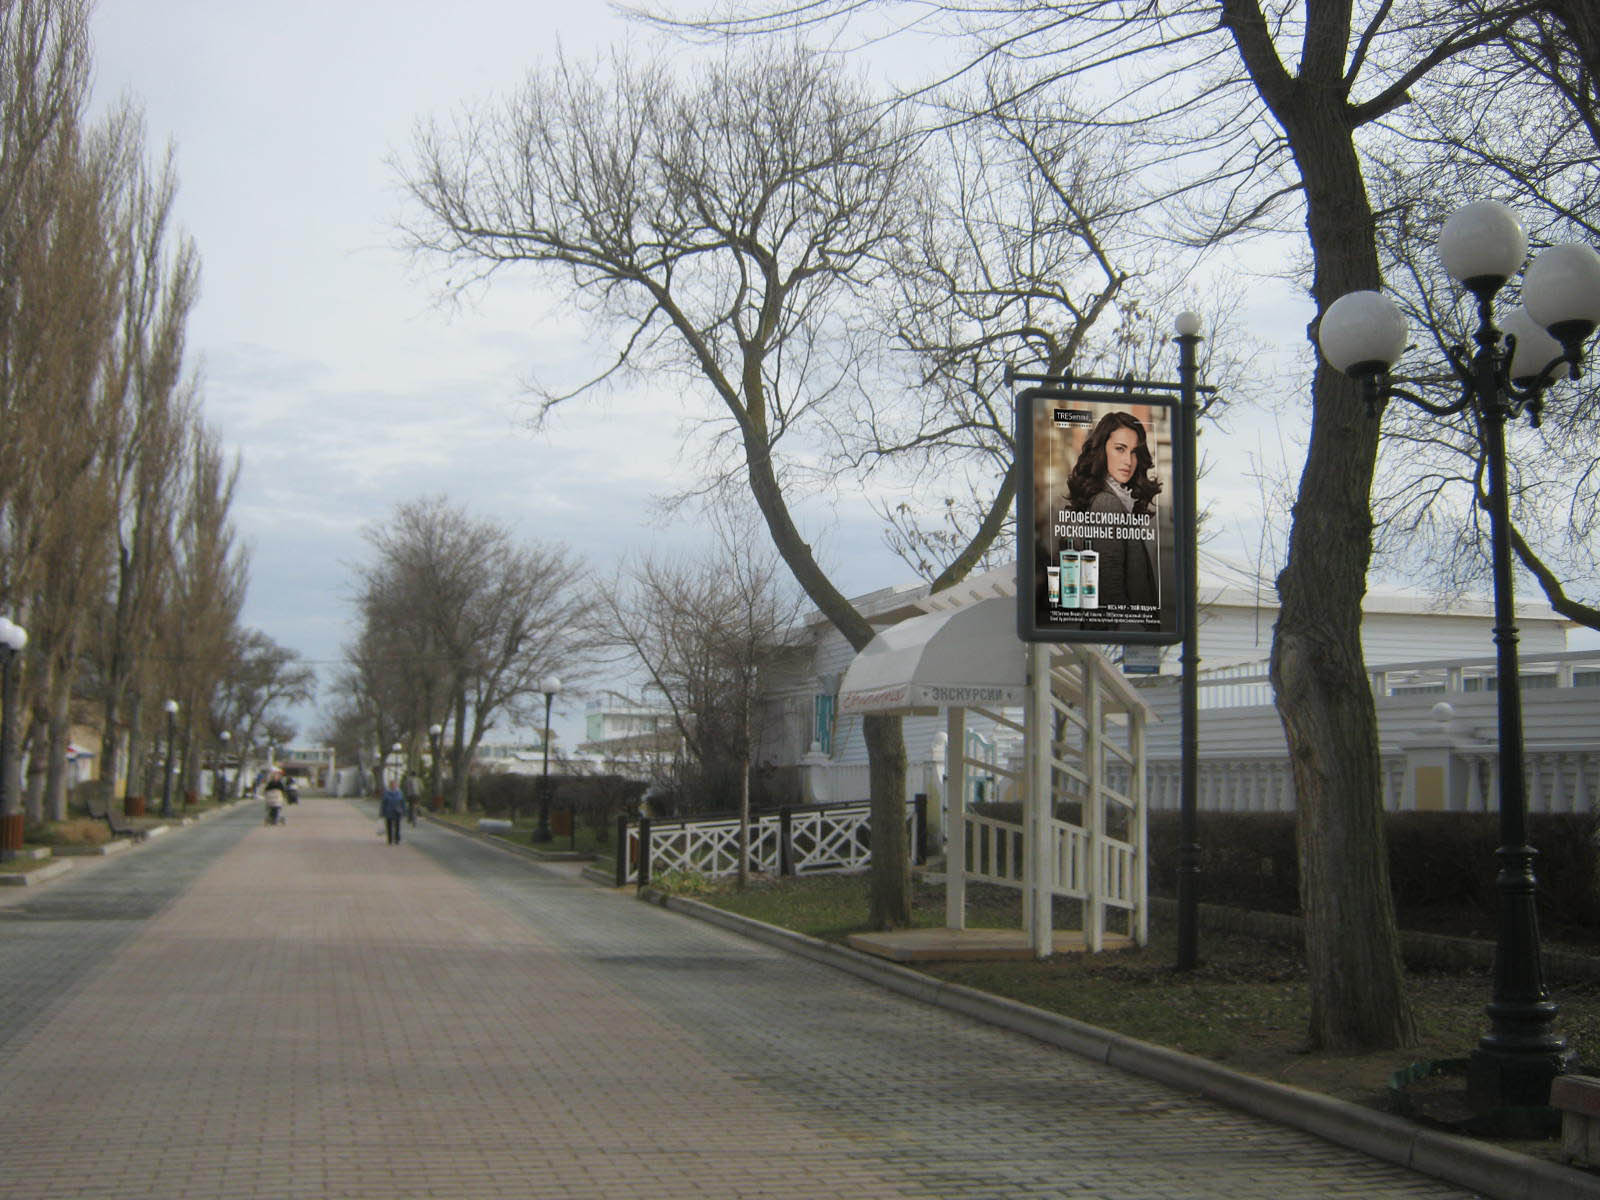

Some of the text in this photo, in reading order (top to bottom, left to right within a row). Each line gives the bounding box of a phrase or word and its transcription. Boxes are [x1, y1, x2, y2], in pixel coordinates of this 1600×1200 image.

[1059, 510, 1150, 527] ПРОФЕССИОНАЛЬНО
[1055, 525, 1155, 541] РОСКОШНЫЕ ВОЛОСЫ
[932, 687, 1002, 701] ЭКСКУРСИИ
